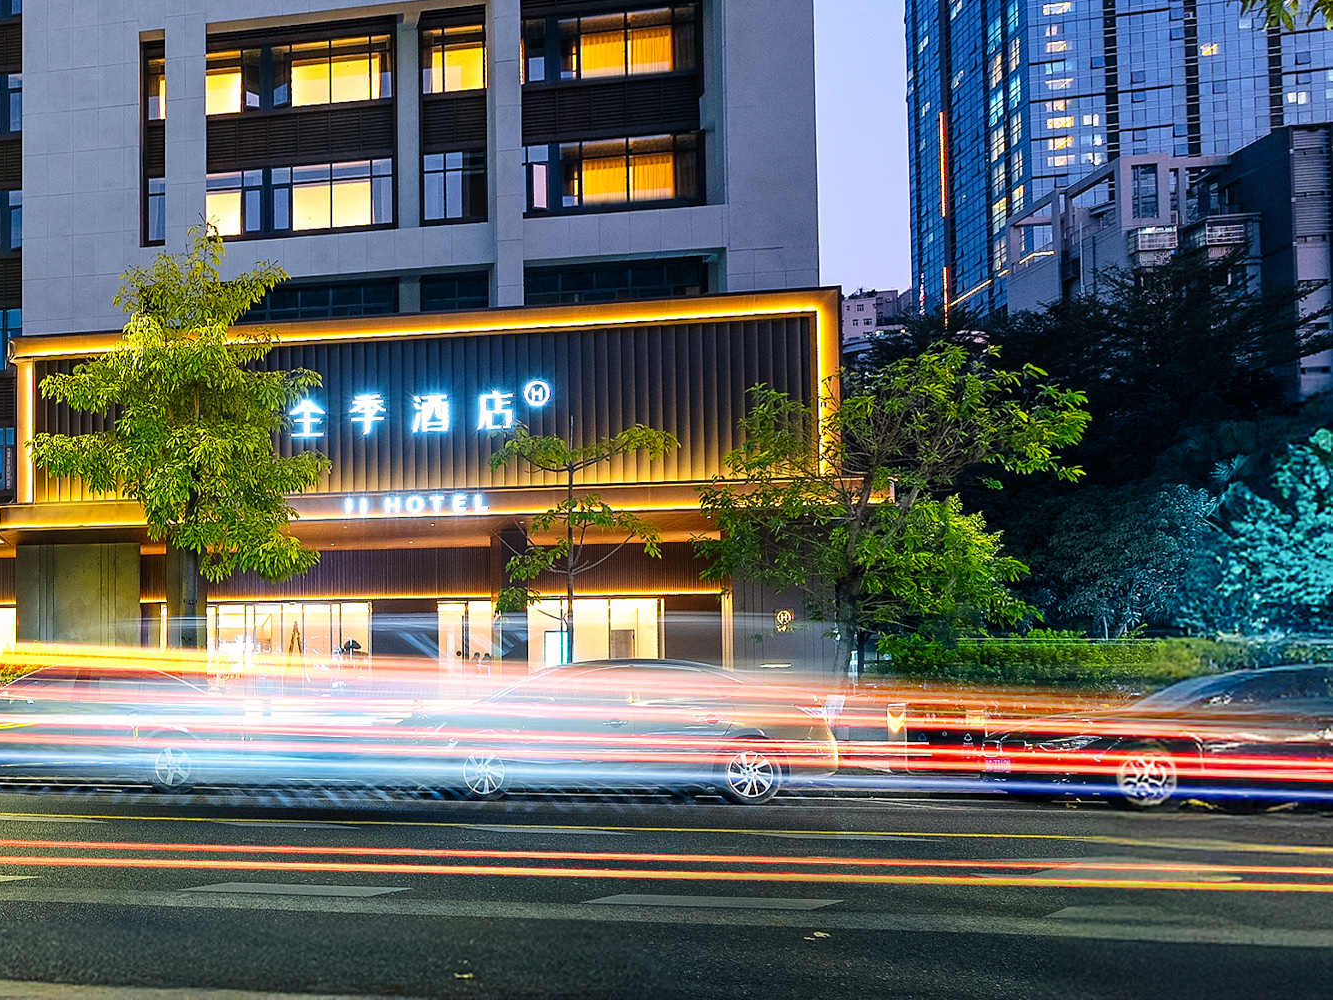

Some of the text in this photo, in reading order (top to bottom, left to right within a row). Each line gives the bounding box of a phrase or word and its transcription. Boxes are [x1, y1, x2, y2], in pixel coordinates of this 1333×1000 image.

[289, 389, 515, 438] 全季酒店
[383, 494, 490, 514] HOTEL
